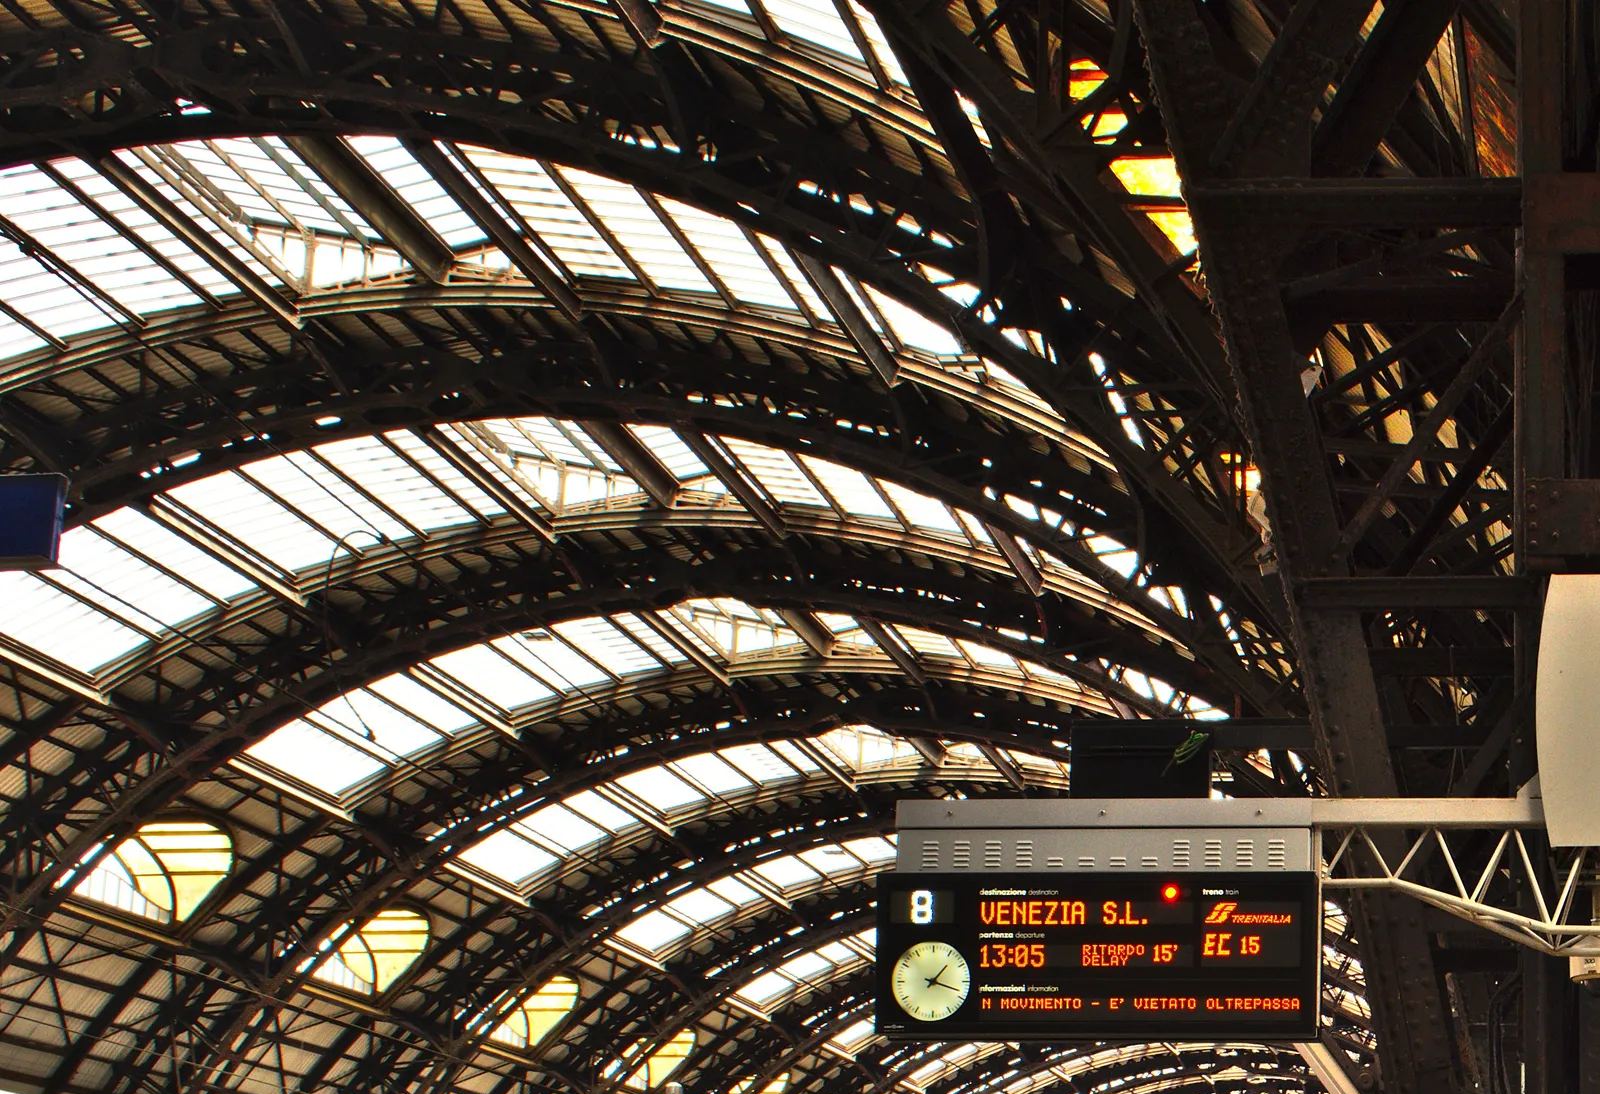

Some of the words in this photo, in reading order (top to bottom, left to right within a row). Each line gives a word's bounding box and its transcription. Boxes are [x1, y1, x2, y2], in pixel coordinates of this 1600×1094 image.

[979, 888, 1027, 896] destinazione
[1202, 888, 1224, 896] treno
[911, 890, 933, 923] 8
[981, 901, 1085, 925] VENEZIA
[1103, 901, 1148, 925] S.L.
[1231, 914, 1291, 924] TRENITALIA
[979, 931, 1014, 939] partenza
[1203, 933, 1232, 955] EC
[1240, 936, 1260, 954] 15
[1083, 944, 1145, 956] RITARDO
[980, 944, 1045, 968] 13:05
[1083, 955, 1128, 966] DELAY
[979, 984, 1026, 993] informazioni
[982, 998, 991, 1010] N
[1001, 998, 1082, 1010] MOVIMENTO
[1134, 998, 1197, 1010] VIETATO
[1206, 998, 1300, 1010] OLTREPASSA
